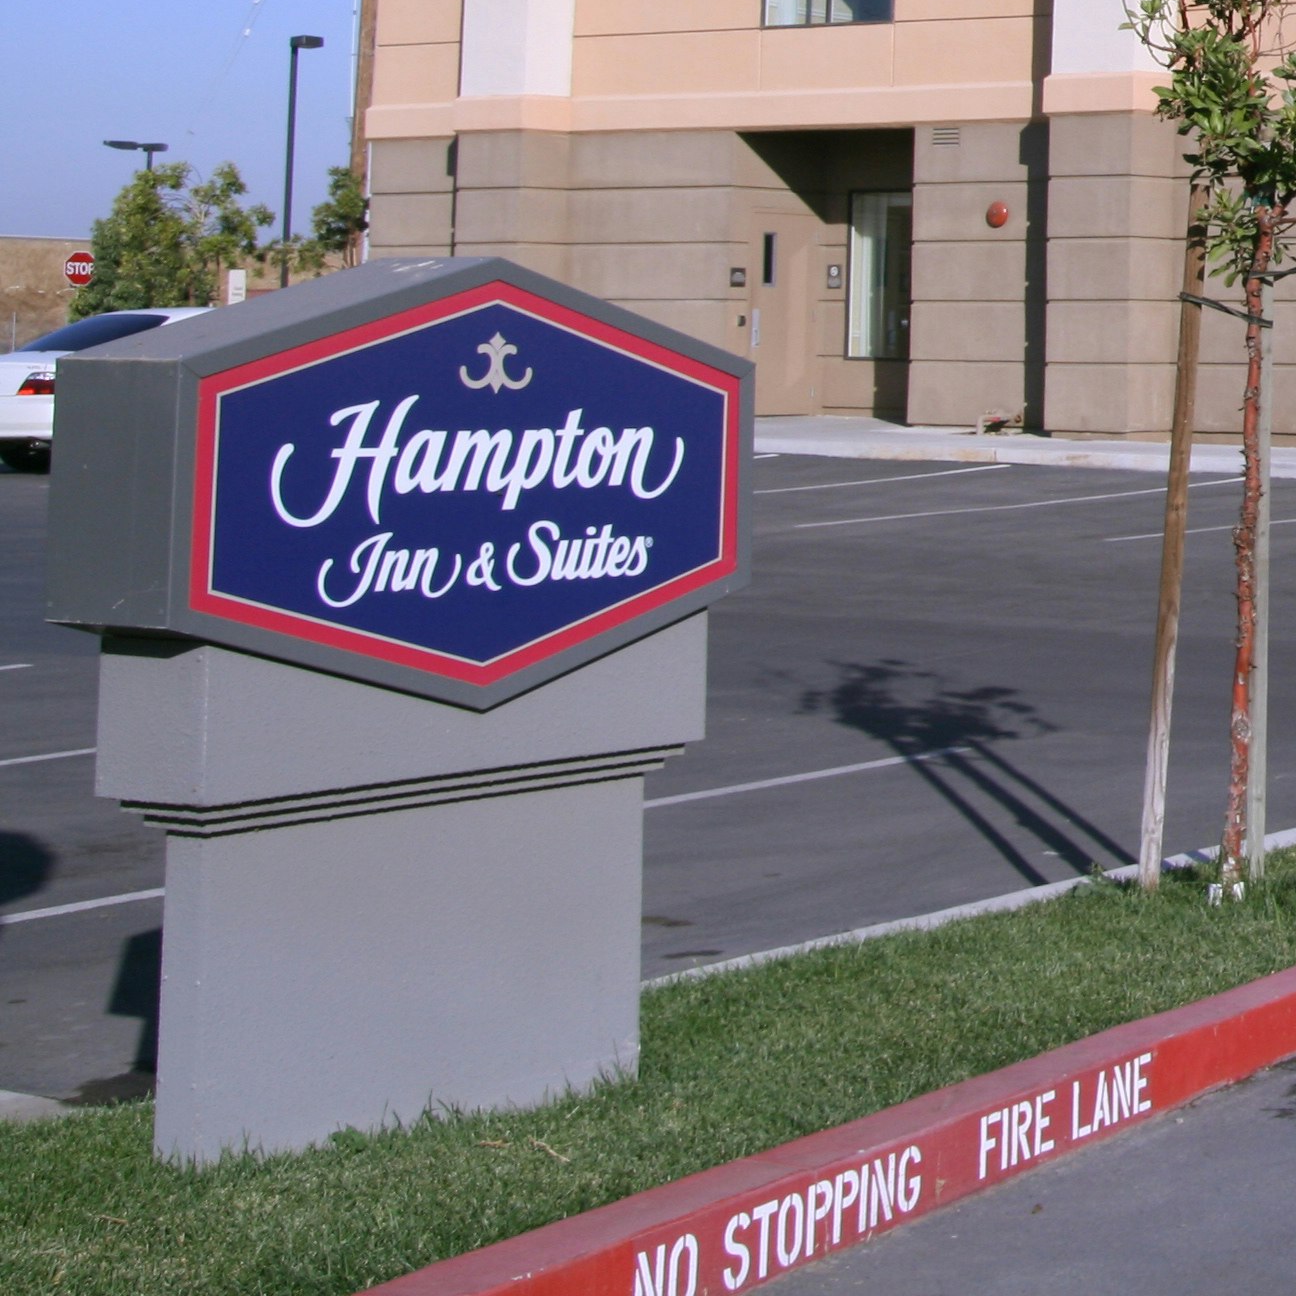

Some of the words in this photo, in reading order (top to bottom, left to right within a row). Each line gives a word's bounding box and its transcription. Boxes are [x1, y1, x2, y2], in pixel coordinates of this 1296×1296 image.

[66, 261, 95, 275] STOP
[271, 394, 684, 528] Hampton
[317, 532, 462, 608] Inn
[466, 541, 502, 590] &
[507, 520, 649, 586] Suites
[634, 1233, 698, 1296] NO
[723, 1144, 922, 1291] STOPPING
[977, 1089, 1057, 1180] FIRE
[1071, 1051, 1153, 1141] LANE
